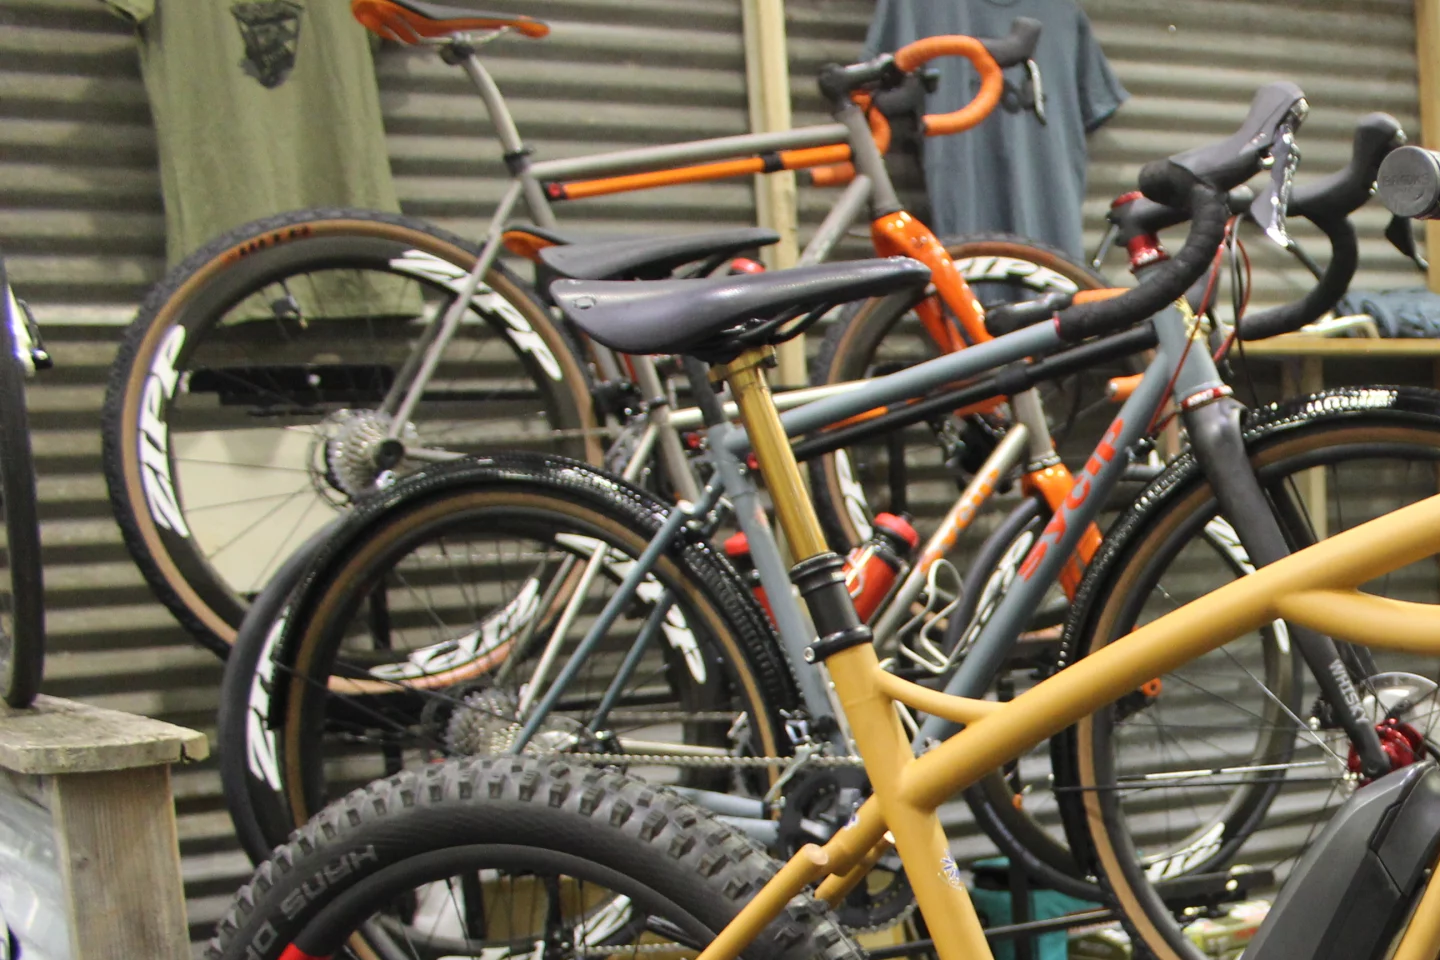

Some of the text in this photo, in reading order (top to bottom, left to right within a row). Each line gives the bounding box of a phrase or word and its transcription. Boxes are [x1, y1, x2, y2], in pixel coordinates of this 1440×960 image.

[137, 324, 190, 538] ZIPP
[1329, 658, 1370, 724] WHISKY
[279, 844, 379, 921] HANS
